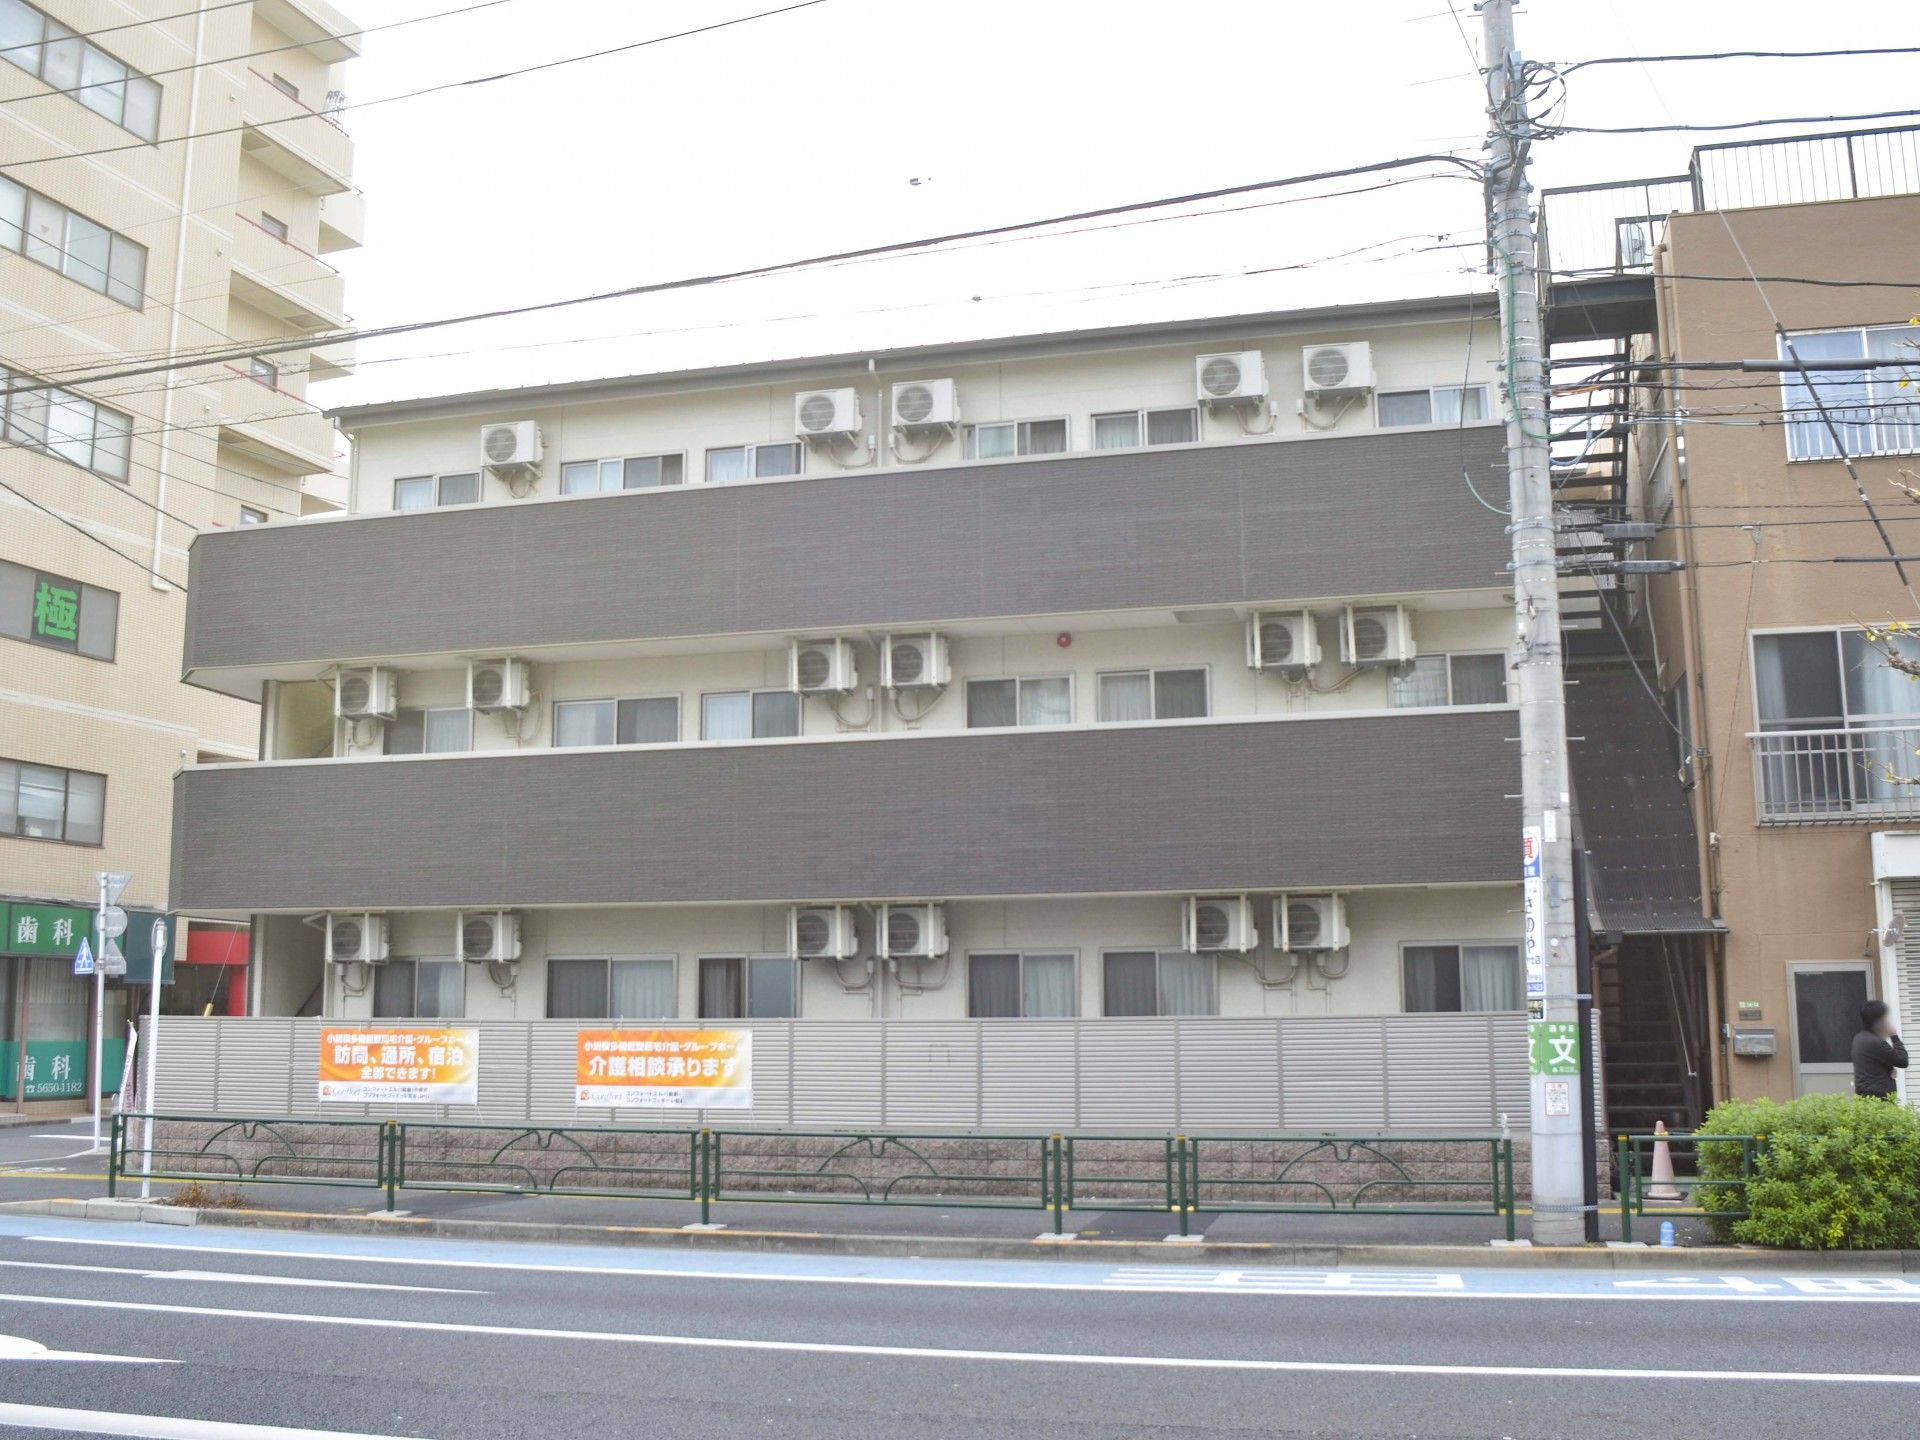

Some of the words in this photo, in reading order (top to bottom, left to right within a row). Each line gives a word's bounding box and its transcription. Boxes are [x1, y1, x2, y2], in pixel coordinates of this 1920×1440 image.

[34, 581, 77, 641] 極
[17, 915, 74, 946] 歯科
[1548, 1034, 1577, 1065] 文
[588, 1056, 739, 1077] 介護相談承ります
[36, 1082, 82, 1093] 5650-1182
